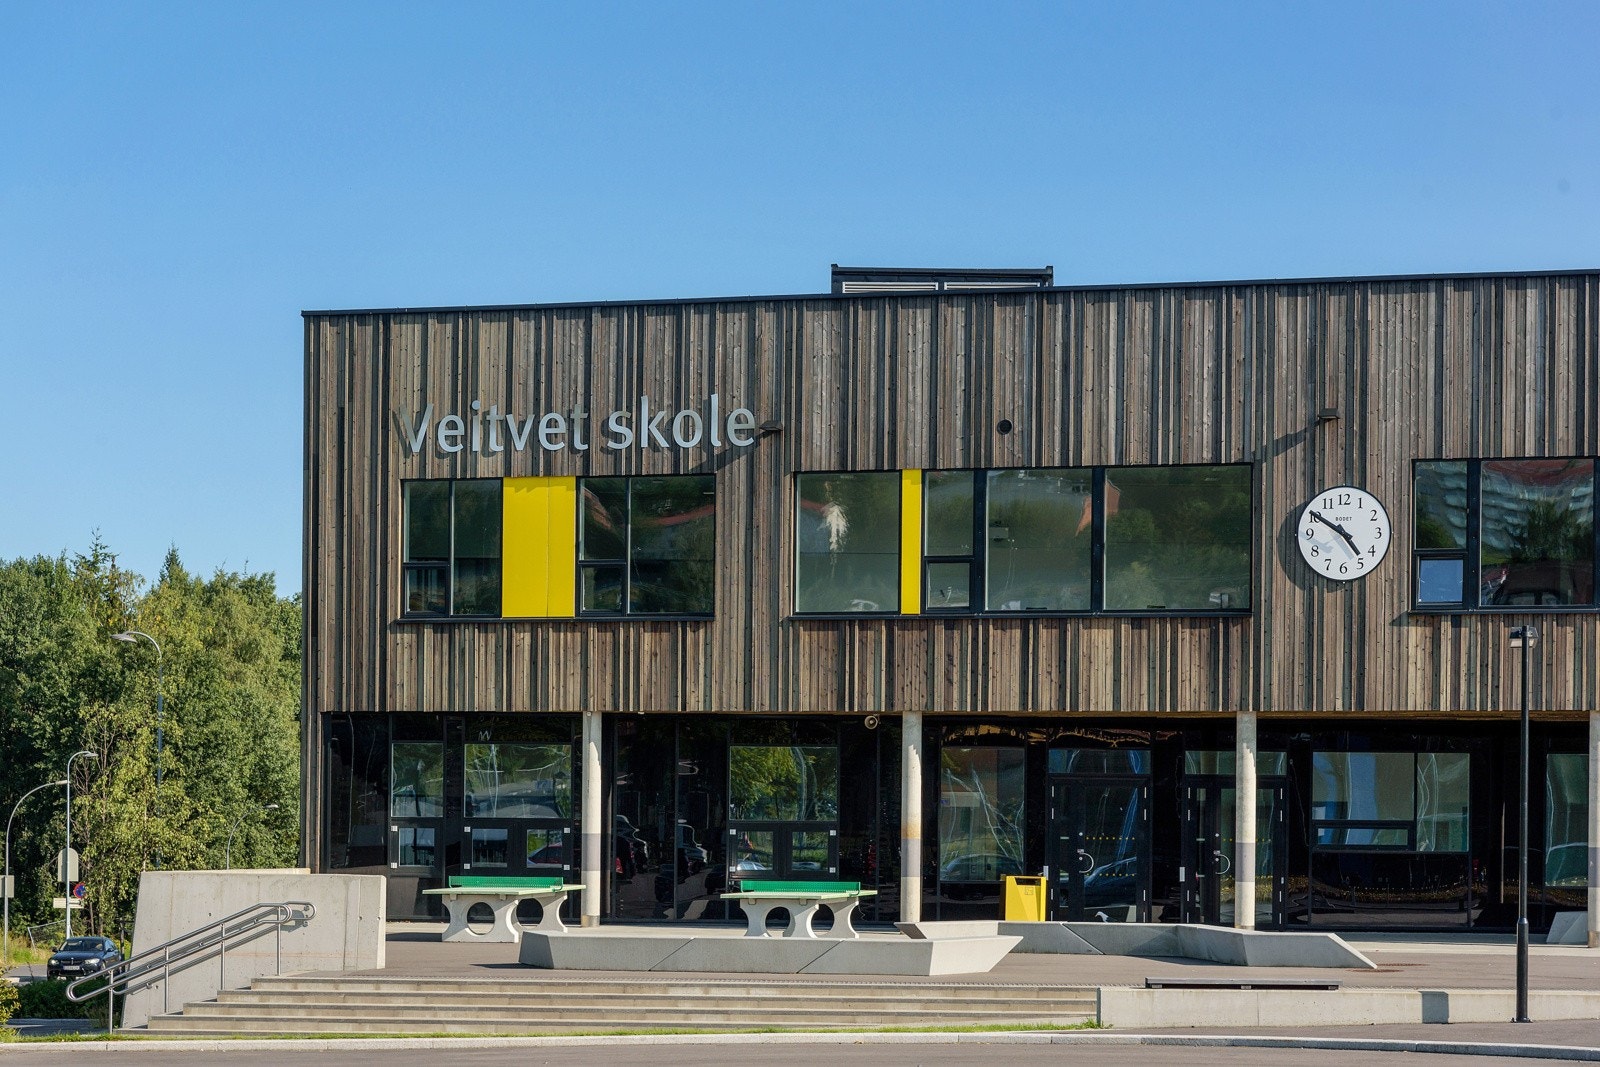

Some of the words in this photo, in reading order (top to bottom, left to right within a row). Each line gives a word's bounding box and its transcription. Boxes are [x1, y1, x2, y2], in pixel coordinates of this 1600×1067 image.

[400, 400, 589, 452] Veitvet
[607, 394, 755, 450] skole
[1322, 498, 1334, 509] 11
[1337, 494, 1351, 505] 12
[1357, 498, 1363, 508] 1
[1370, 510, 1378, 521] 2
[1306, 528, 1314, 540] 9
[1374, 527, 1382, 539] 3
[1311, 545, 1319, 557] 8
[1368, 545, 1376, 557] 4
[1324, 559, 1332, 570] 7
[1340, 562, 1348, 574] 6
[1356, 558, 1364, 570] 5
